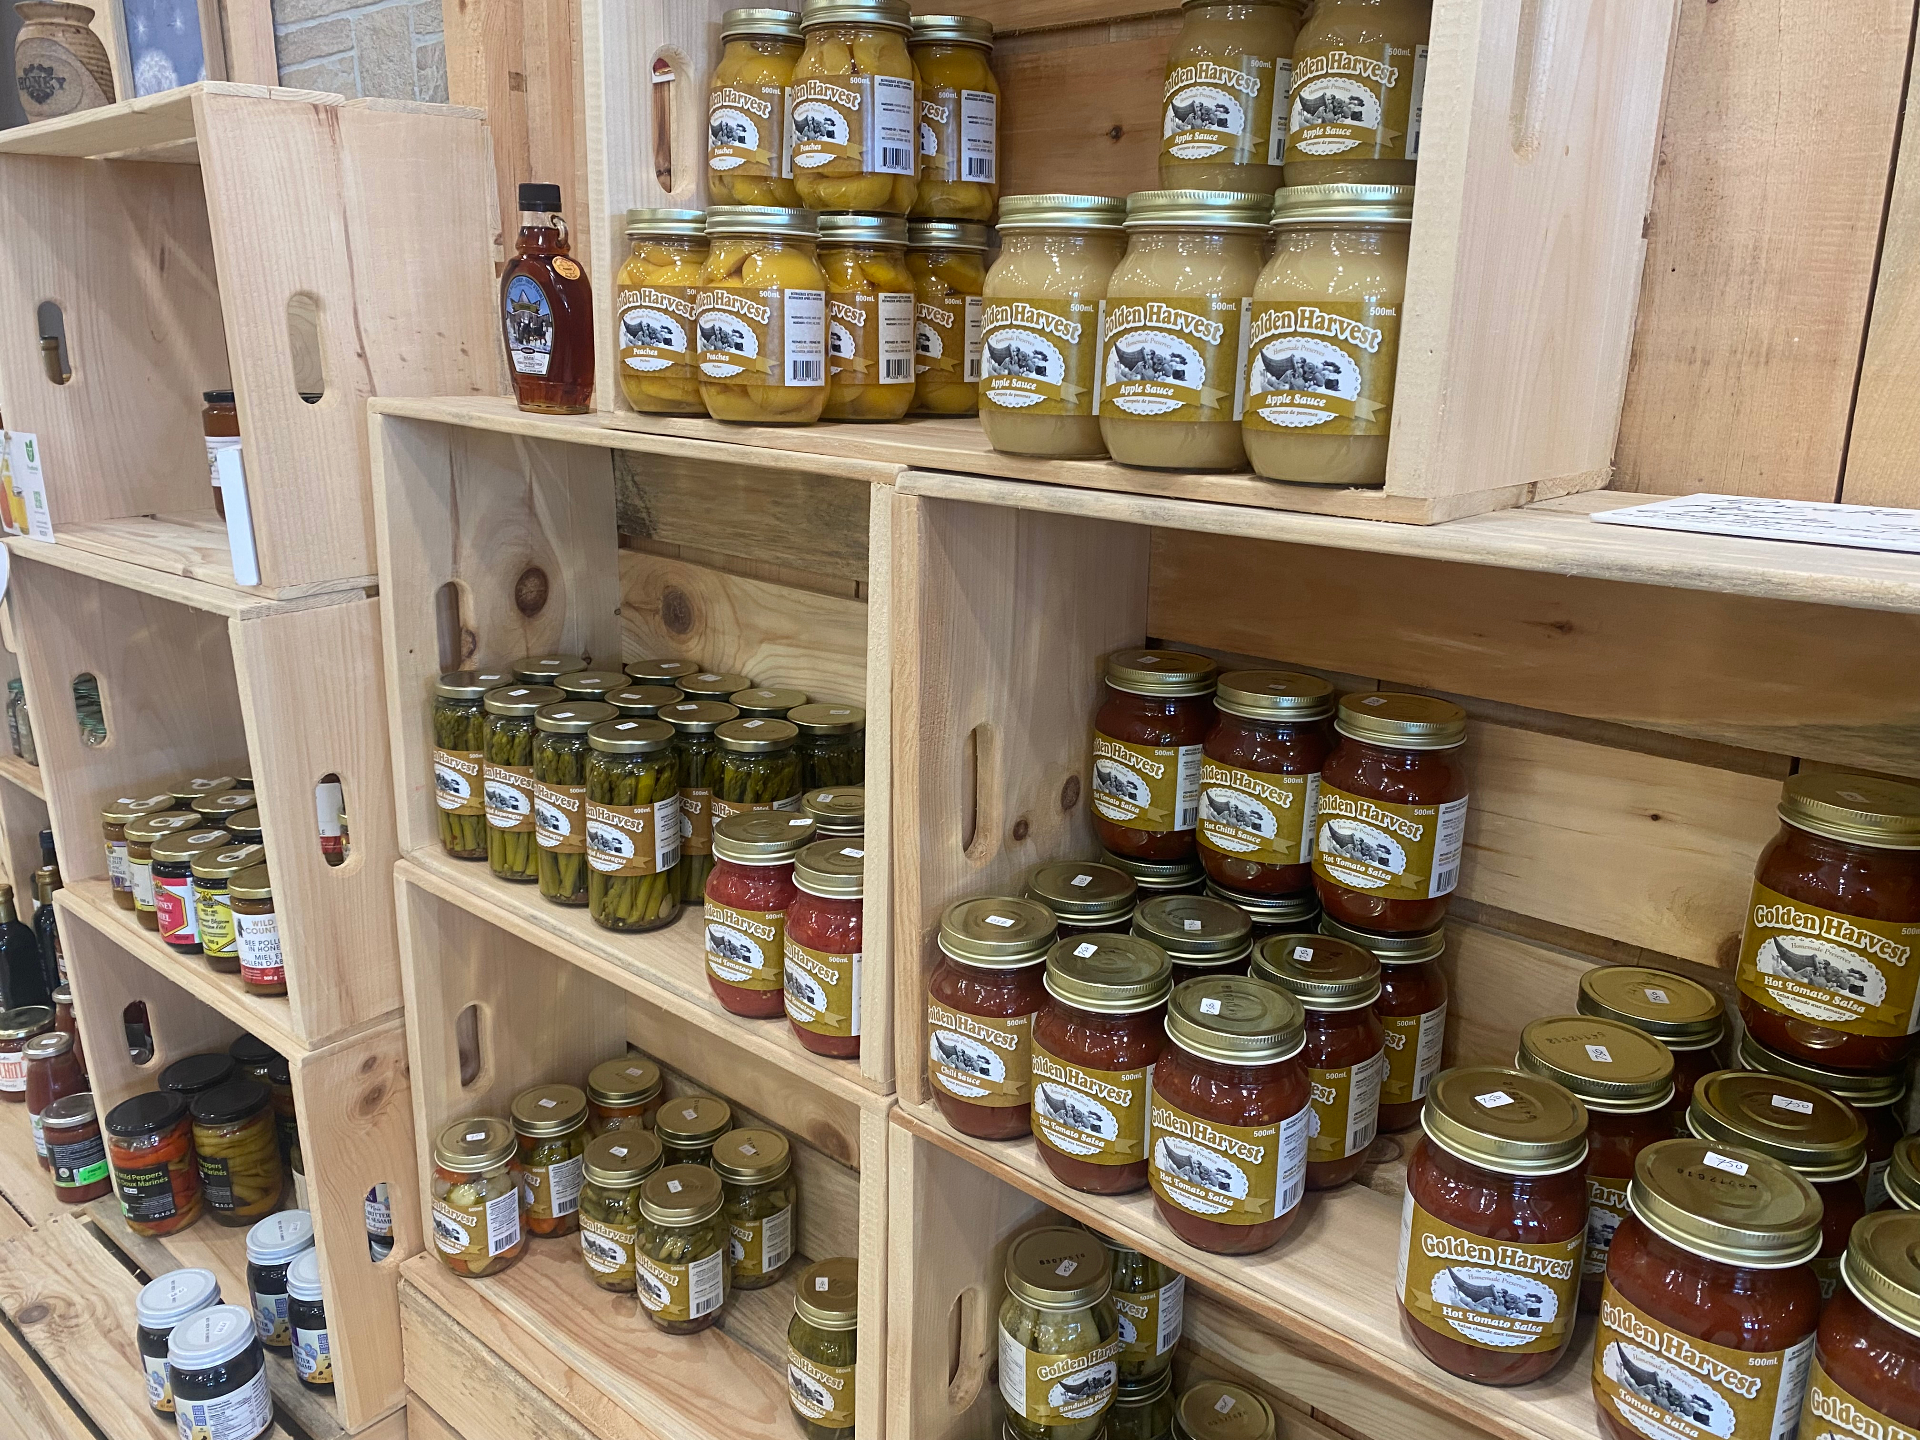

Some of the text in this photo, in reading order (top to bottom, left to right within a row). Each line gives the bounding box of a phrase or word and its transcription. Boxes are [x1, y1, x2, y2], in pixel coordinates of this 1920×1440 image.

[1388, 48, 1410, 56] 500mL
[1251, 60, 1272, 69] 500mL
[1328, 51, 1399, 88] Harvest
[17, 76, 66, 91] HONEY
[1197, 62, 1260, 97] Harvest
[762, 87, 781, 95] 500mL
[807, 80, 861, 110] Harvest
[723, 88, 772, 118] Harvest
[1174, 132, 1218, 144] Apple Sauce
[1302, 126, 1352, 138] Apple Sauce
[714, 147, 733, 155] Peaches
[800, 143, 822, 152] Peaches
[641, 288, 697, 320] Harvest
[759, 290, 780, 298] 500mL
[714, 290, 770, 324] Harvest
[1070, 303, 1094, 312] 500mL
[1211, 302, 1236, 311] 500mL
[1369, 307, 1396, 316] 500mL
[1012, 302, 1082, 344] Harvest
[1146, 302, 1224, 346] Harvest
[1297, 307, 1382, 353] Harvest
[633, 347, 658, 356] Peaches
[1125, 337, 1173, 349] Homemade Preserves
[1273, 344, 1325, 357] Homemade Preserves
[706, 353, 729, 361] Peaches
[991, 378, 1036, 390] Apple Sauce
[1120, 383, 1174, 396] Apple Sauce
[1265, 394, 1326, 407] Apple Sauce
[439, 751, 478, 776] Harvest
[1112, 742, 1164, 779] Harvest
[539, 786, 579, 811] Harvest
[1232, 770, 1293, 808] Harvest
[1101, 795, 1139, 813] Tomato Salsa
[597, 807, 644, 832] Harvest
[1357, 800, 1423, 842] Harvest
[1204, 821, 1261, 843] Hot Chilli Sauce
[597, 852, 626, 864] Asparagus
[1323, 854, 1392, 880] Hot Tomato Salsa
[246, 926, 278, 935] COUNT
[252, 919, 274, 927] WILD
[724, 909, 775, 941] Harvest
[1754, 905, 1910, 967] Golden Harvest
[242, 958, 263, 966] POLLEN
[1791, 942, 1852, 964] Homemade Preserves
[723, 959, 752, 974] Tomatoes
[793, 945, 839, 985] Harvest
[1764, 976, 1866, 1014] Hot Tomato Salsa
[1790, 994, 1810, 1006] chaude
[1823, 1005, 1846, 1016] tomates
[956, 1015, 1018, 1050] Harvest
[1007, 1018, 1027, 1026] 500mL
[941, 1066, 980, 1086] Chilli Sauce
[1066, 1067, 1132, 1107] Harvest
[1122, 1073, 1143, 1081] 500mL
[1039, 1116, 1105, 1148] Hot Tomato Salsa
[1152, 1106, 1191, 1138] Golden
[1192, 1121, 1265, 1165] Harvest
[1253, 1128, 1276, 1137] 500mL
[1715, 1157, 1743, 1170] 750
[132, 1171, 162, 1181] Peppers
[138, 1176, 168, 1187] Marinés
[1160, 1172, 1234, 1206] Hot Tomato Salsa
[440, 1201, 477, 1227] Harvest
[594, 1222, 635, 1245] Harvest
[1422, 1233, 1574, 1280] Golden Harvest
[642, 1255, 679, 1286] Harvest
[1468, 1274, 1528, 1290] Homemade Preserves
[1442, 1306, 1542, 1333] Hot Tomato Salsa
[1602, 1300, 1761, 1399] Golden Harvest
[1037, 1357, 1087, 1381] Golden
[1632, 1354, 1694, 1390] Homemade Preserves
[1748, 1357, 1778, 1366] 500mL
[801, 1358, 844, 1390] Harvest
[806, 1401, 826, 1415] Pickles
[1059, 1397, 1094, 1412] Sandwich
[1619, 1388, 1699, 1438] Tomato Salsa
[1811, 1387, 1883, 1440] Golden
